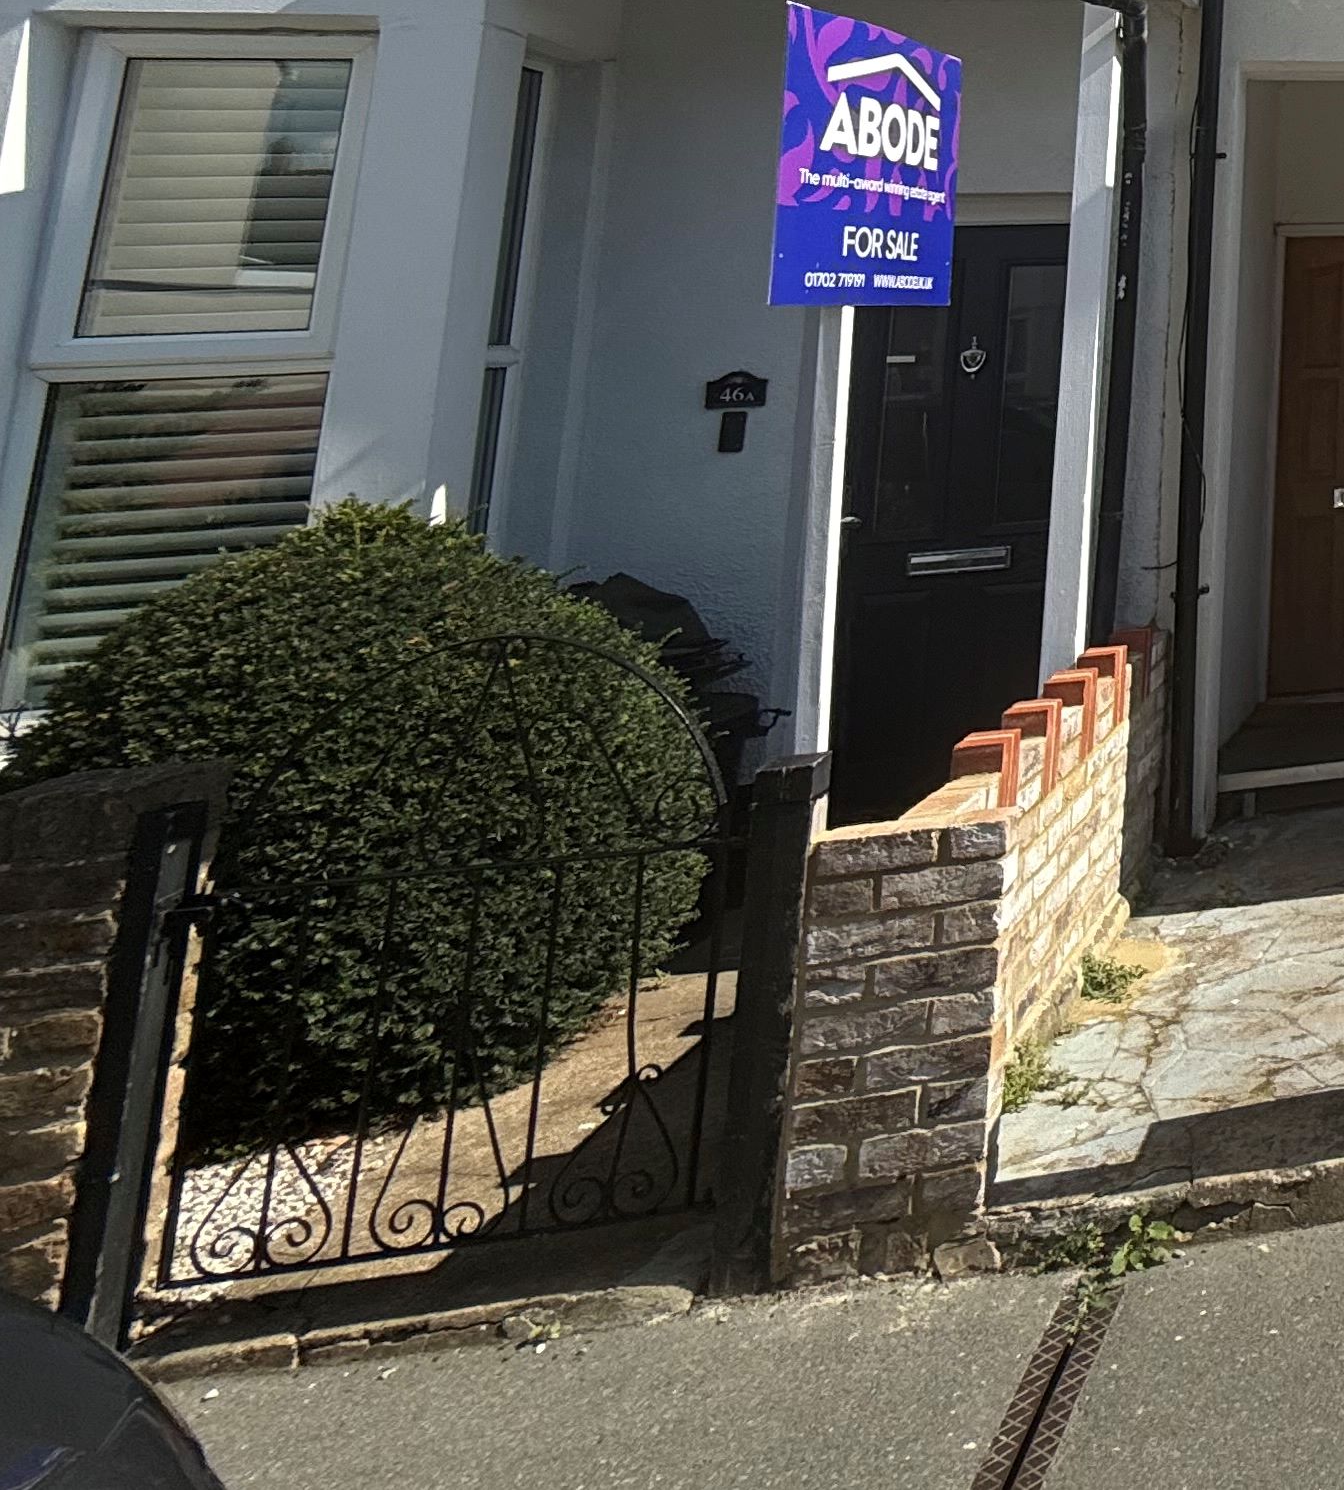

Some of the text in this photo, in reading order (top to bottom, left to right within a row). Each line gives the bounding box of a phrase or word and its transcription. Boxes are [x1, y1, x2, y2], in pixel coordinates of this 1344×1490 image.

[819, 91, 940, 171] ABODE
[799, 167, 820, 185] The
[821, 172, 884, 193] multi-award
[842, 225, 920, 261] FOR SALE
[804, 271, 837, 288] 01702
